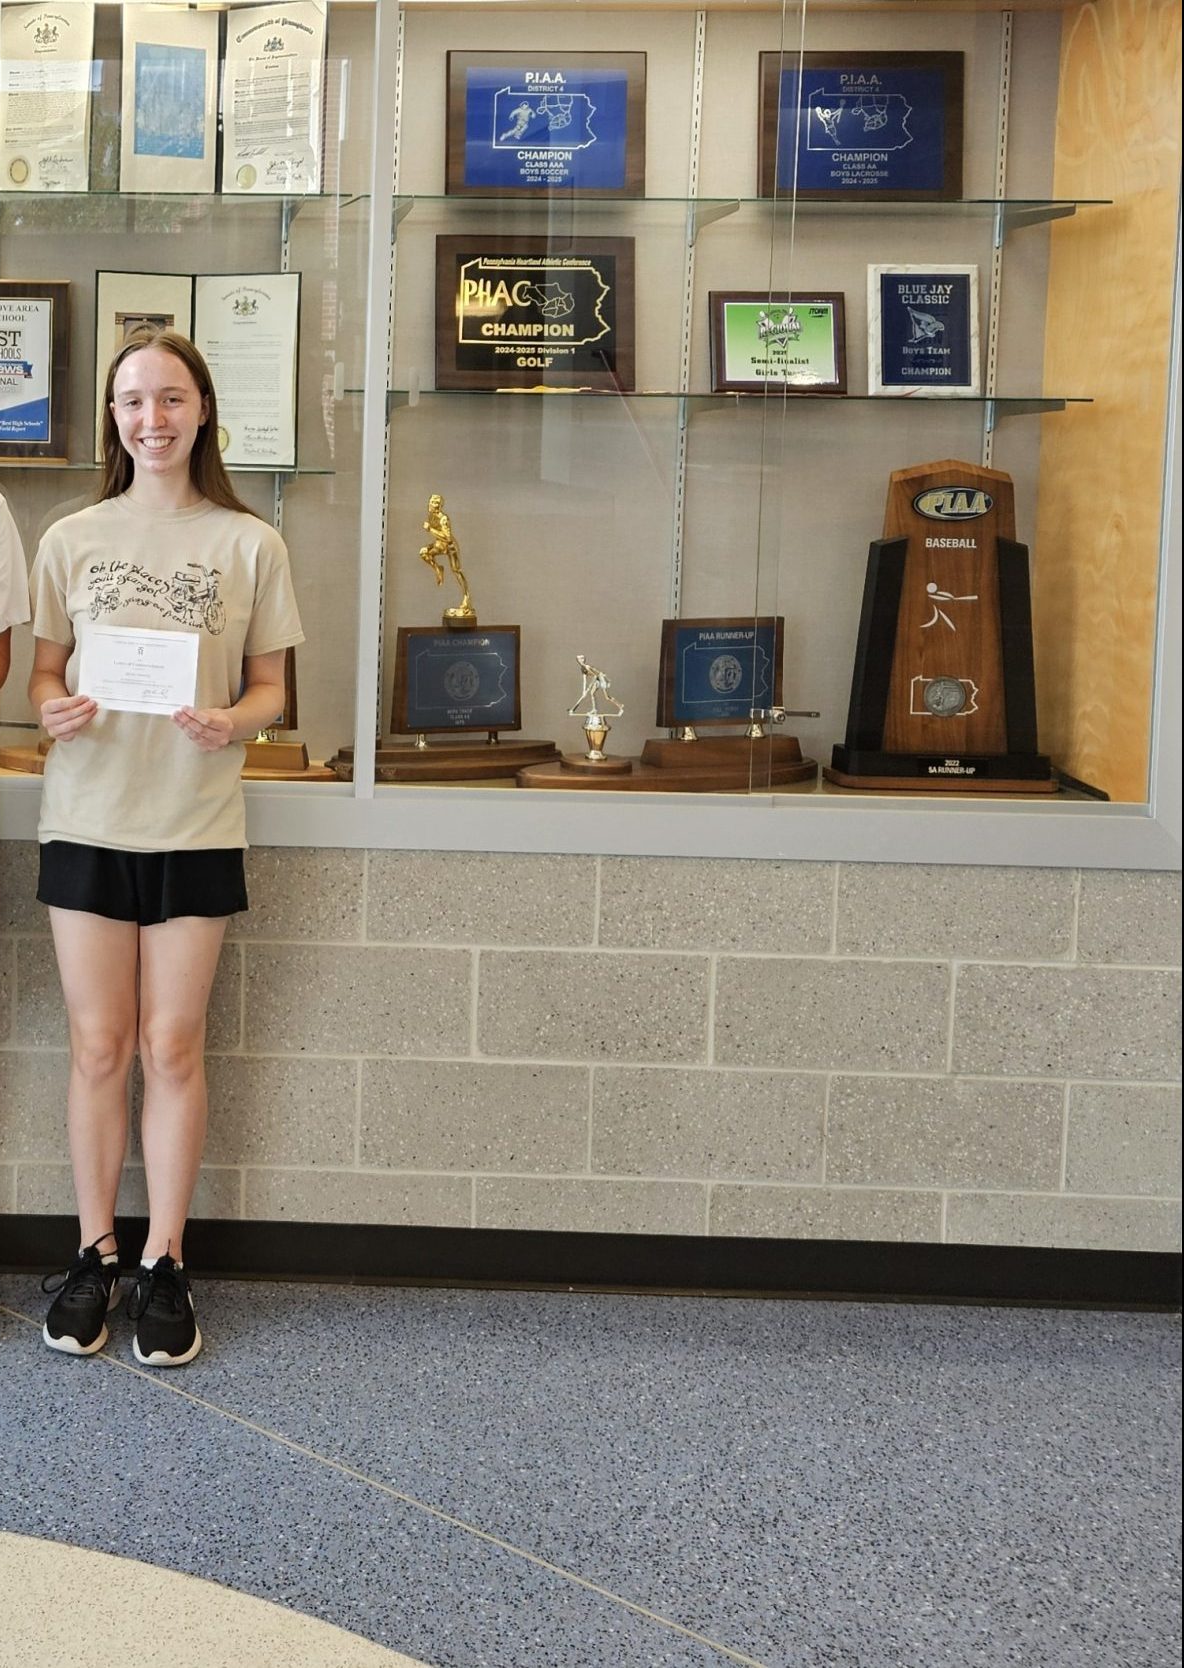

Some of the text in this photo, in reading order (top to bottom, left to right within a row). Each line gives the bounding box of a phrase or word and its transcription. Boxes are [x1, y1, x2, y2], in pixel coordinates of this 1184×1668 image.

[525, 72, 566, 84] P.I.A.A.
[840, 74, 882, 84] P.I.A.A.
[517, 151, 572, 160] CHAMPION
[831, 153, 888, 162] CHAMPION
[483, 257, 515, 266] Pennsylvania
[516, 257, 542, 265] Heartland
[542, 257, 562, 265] Athletic
[464, 278, 531, 307] PHAC
[898, 284, 953, 294] BLUE JAY
[901, 295, 950, 304] CLASSIC
[15, 304, 39, 312] AREA
[481, 323, 575, 336] CHAMPION
[516, 357, 554, 367] GOLF
[919, 491, 988, 514] PIAA
[925, 537, 977, 549] BASEBALL
[699, 631, 754, 640] PIAA RUNNER-UP
[937, 766, 976, 774] RUNNER-UP
